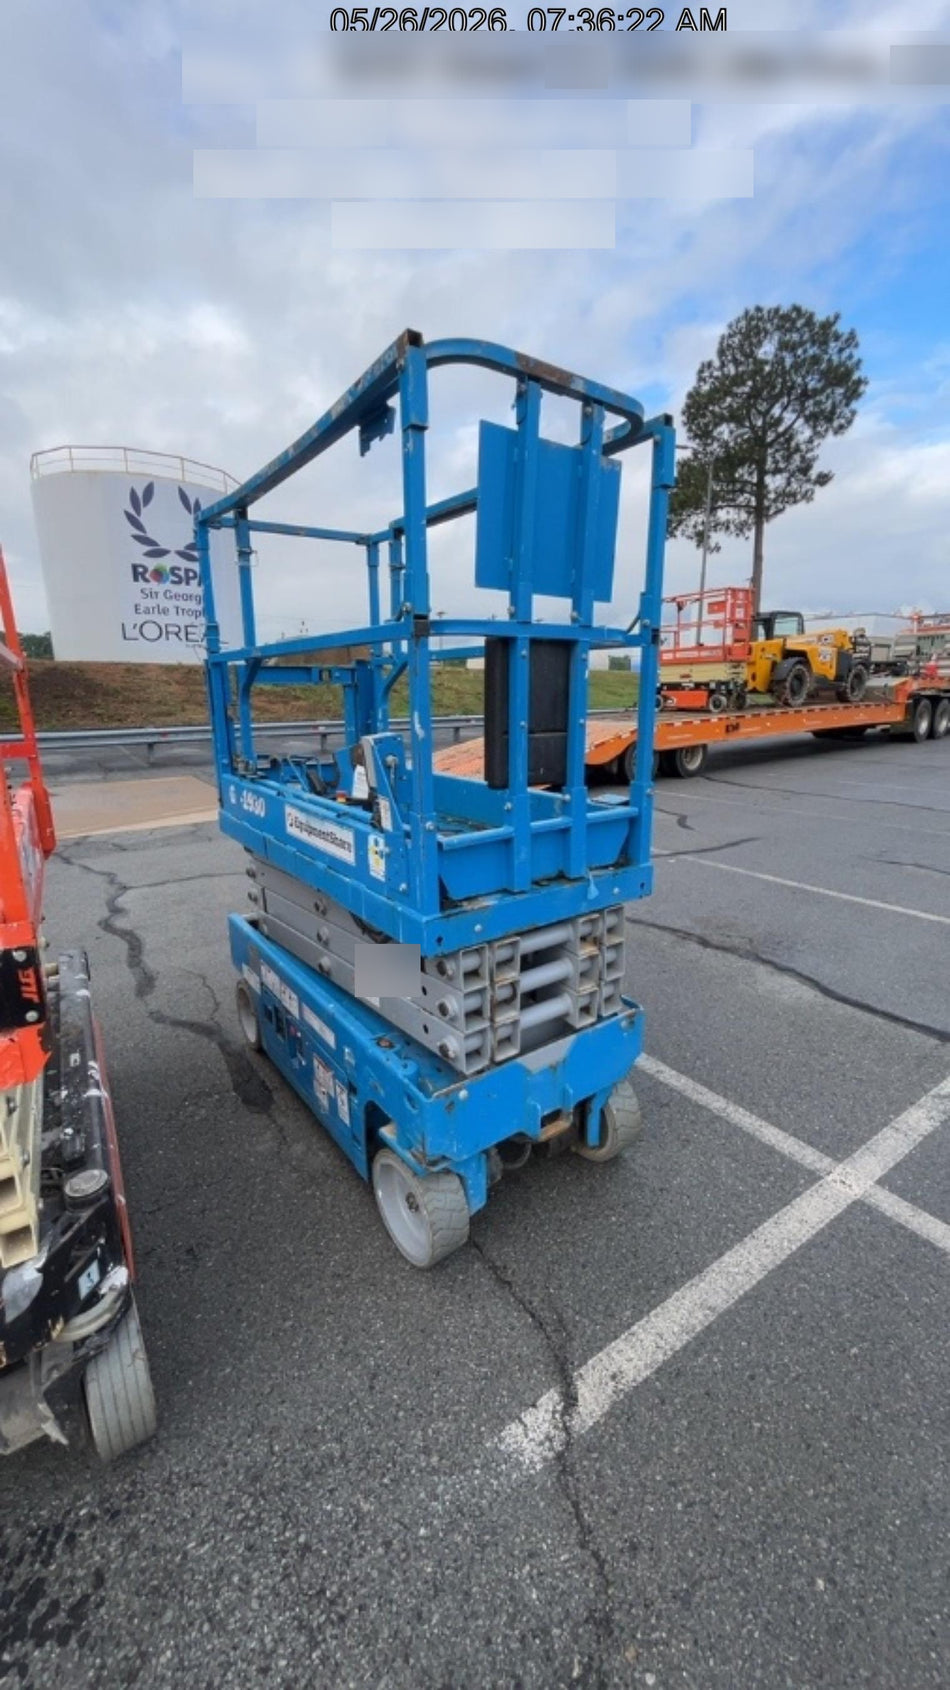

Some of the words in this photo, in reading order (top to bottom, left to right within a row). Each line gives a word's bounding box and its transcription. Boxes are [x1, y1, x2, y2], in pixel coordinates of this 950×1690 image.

[140, 588, 160, 599] Sir
[163, 589, 202, 605] Georg
[134, 603, 170, 616] Earle
[174, 605, 204, 620] Trop
[18, 966, 41, 1003] JLG
